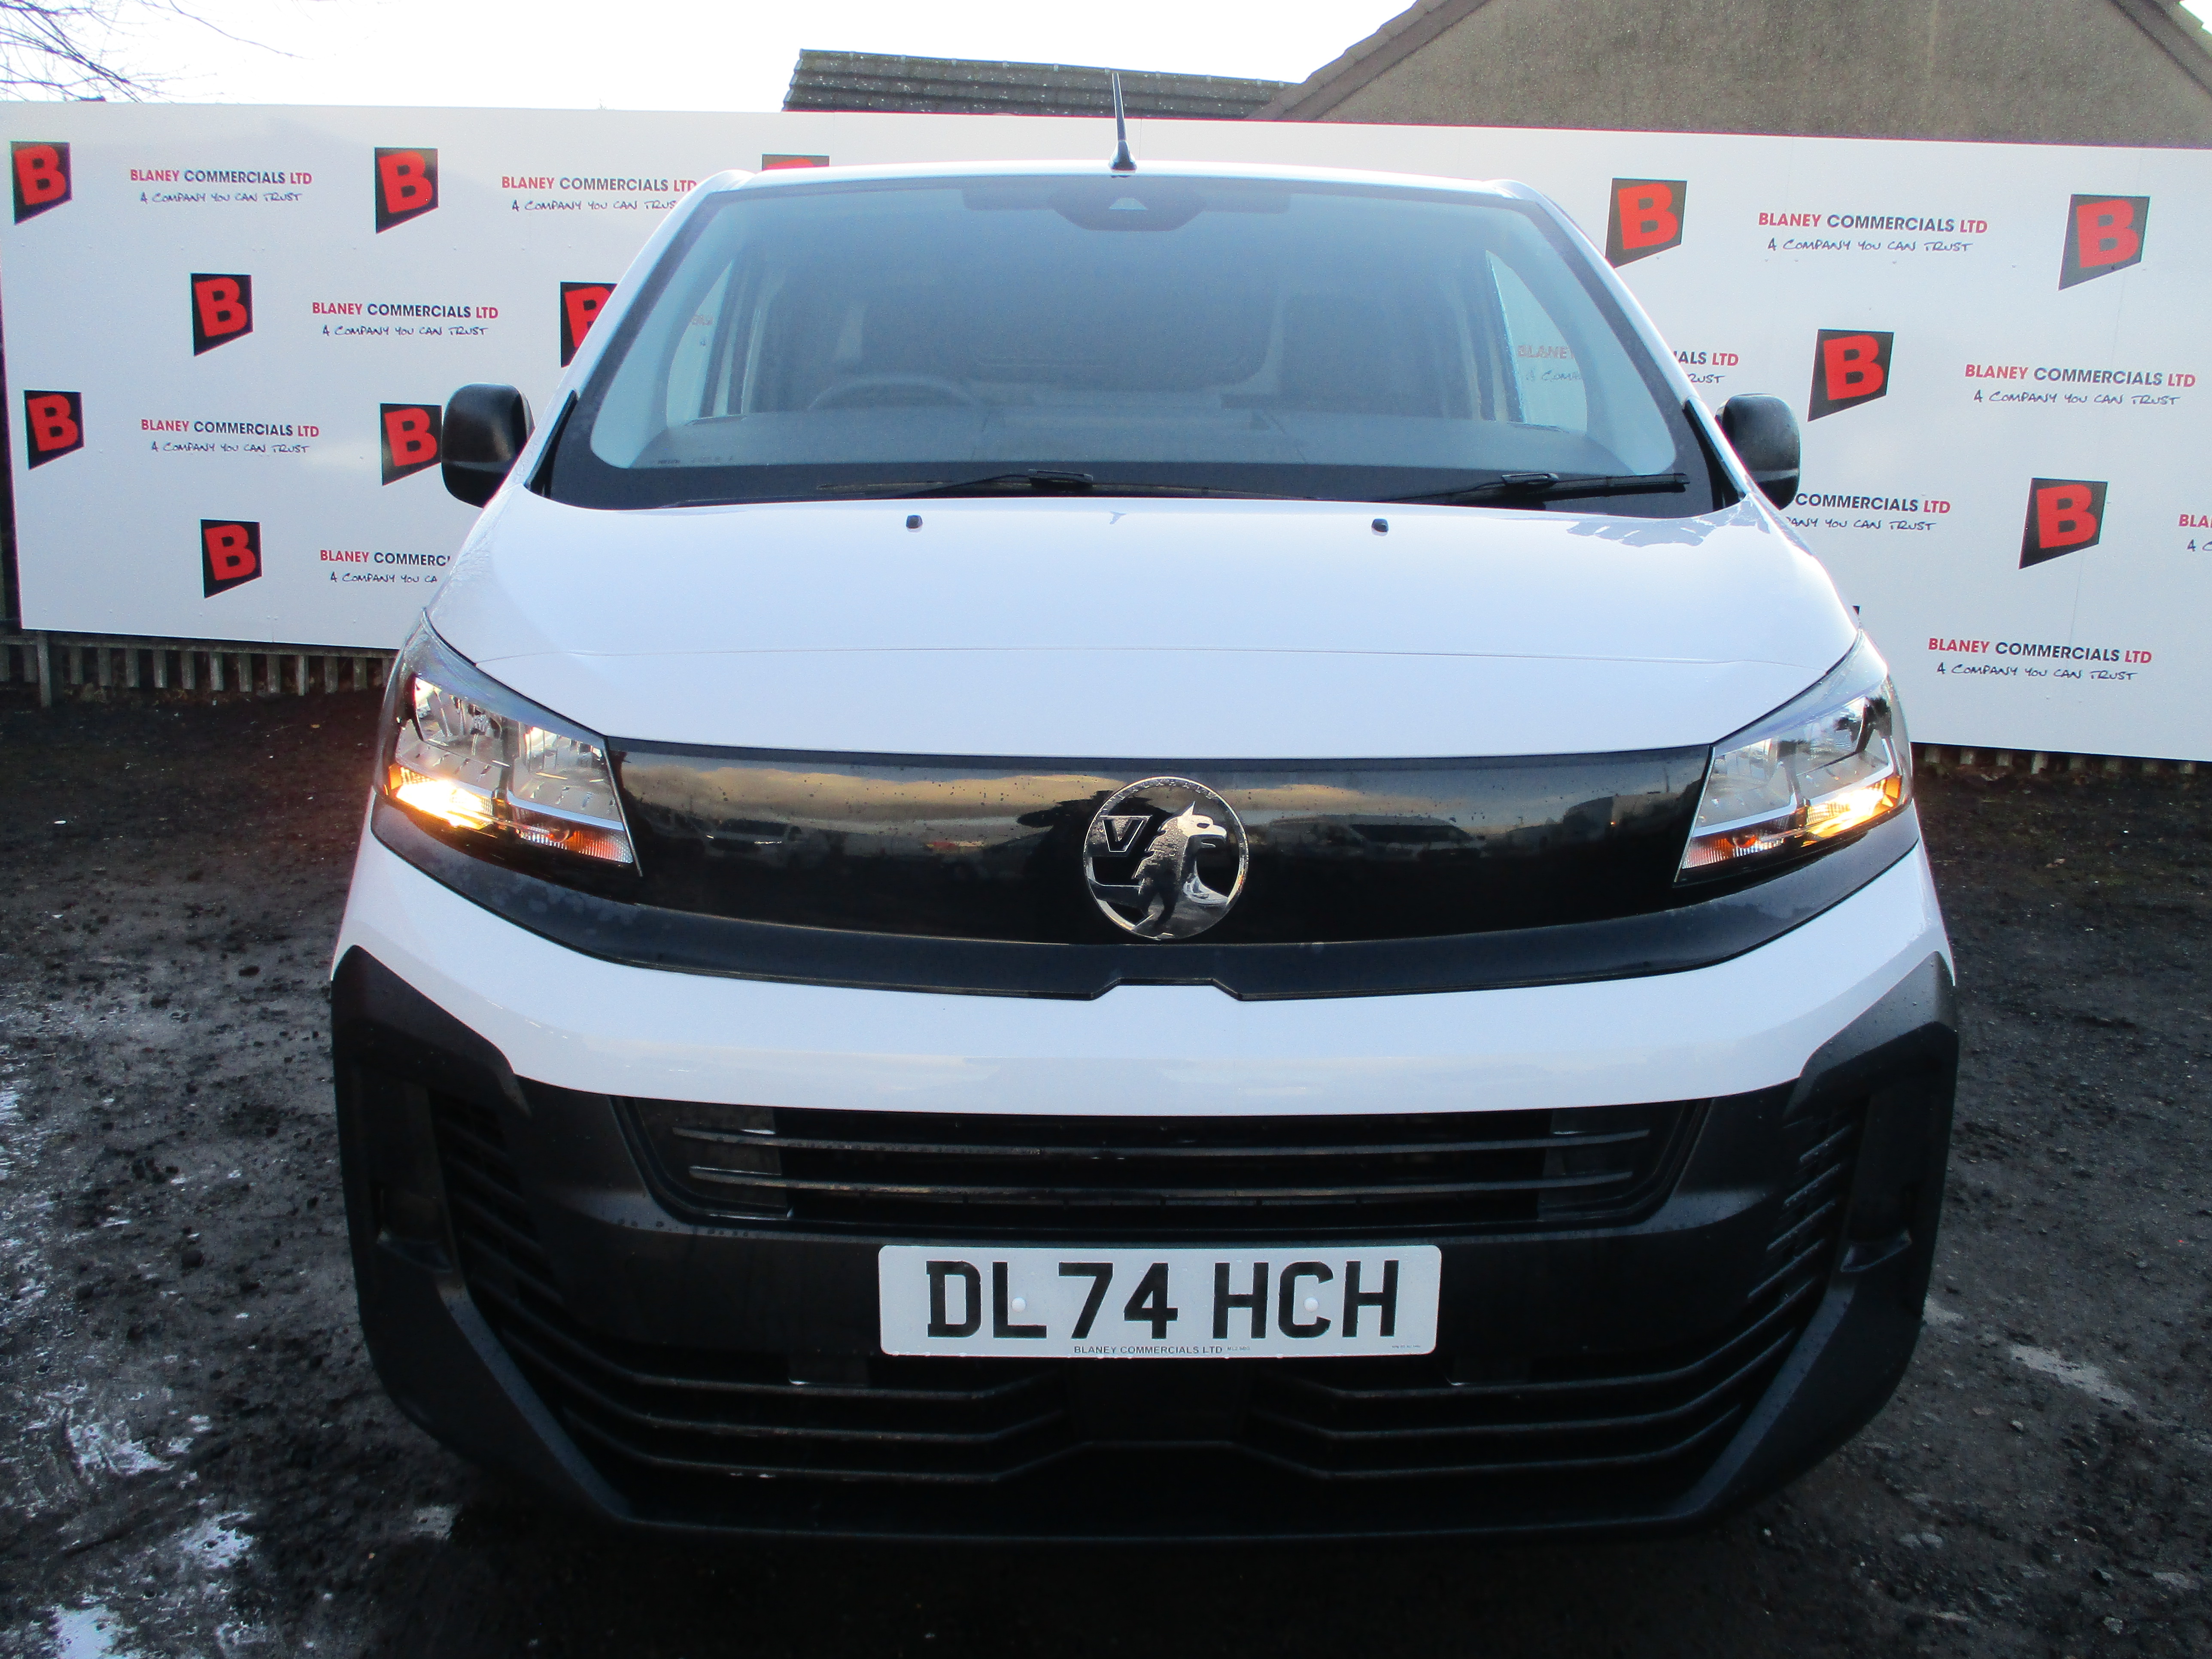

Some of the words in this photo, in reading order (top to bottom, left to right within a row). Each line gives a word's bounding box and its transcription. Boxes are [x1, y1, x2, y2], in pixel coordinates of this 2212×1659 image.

[14, 145, 66, 205] B
[130, 169, 180, 182] BLANEY
[184, 170, 286, 184] COMMERCIALS
[290, 172, 312, 185] LTD
[378, 151, 434, 213] B
[502, 176, 555, 189] BLANEY
[559, 177, 668, 192] COMMERCIALS
[674, 179, 696, 192] LTD
[140, 192, 148, 204] A
[152, 192, 206, 202] COMPANY
[211, 193, 230, 202] YOU
[235, 193, 258, 202] CAN
[263, 192, 302, 202] TRUST
[512, 199, 520, 212] A
[524, 200, 581, 210] COMPANY
[588, 201, 608, 210] YOU
[613, 201, 638, 210] CAN
[644, 200, 675, 210] TRUS
[1618, 183, 1678, 249] B
[1759, 212, 1822, 227] BLANEY
[1827, 214, 1954, 232] COMMERCIALS
[1960, 219, 1987, 233] LTD
[2078, 200, 2137, 267] B
[1768, 237, 1777, 251] A
[1782, 239, 1851, 250] COMPANY
[1858, 240, 1881, 250] YOU
[1887, 241, 1916, 252] CAN
[1923, 241, 1973, 252] TRUST
[194, 277, 248, 337] B
[312, 302, 362, 315] BLANEY
[367, 304, 471, 318] COMMERCIALS
[476, 307, 498, 319] LTD
[322, 325, 330, 337] A
[334, 325, 389, 336] COMPANY
[395, 327, 414, 335] YOU
[419, 327, 442, 336] CAN
[448, 326, 488, 335] TRUST
[1712, 352, 1739, 366] LTD
[1823, 334, 1884, 400] B
[1687, 373, 1725, 383] RUST
[1965, 364, 2029, 380] BLANEY
[2033, 368, 2163, 386] COMMERCIALS
[2168, 374, 2196, 387] LTD
[1973, 389, 1983, 403] A
[1989, 391, 2057, 403] COMPANY
[2064, 393, 2087, 403] YOU
[2094, 394, 2123, 404] CAN
[2131, 395, 2180, 405] TRUST
[28, 395, 78, 451] B
[141, 419, 189, 432] BLANEY
[194, 421, 293, 436] COMMERCIALS
[298, 425, 319, 437] LTD
[384, 407, 438, 467] B
[152, 441, 158, 452] A
[163, 442, 215, 452] COMPANY
[220, 444, 239, 452] YOU
[243, 444, 266, 453] CAN
[272, 444, 309, 453] TRUST
[1794, 492, 1918, 512] COMMERCIALS
[1923, 500, 1951, 514] LTD
[1825, 519, 1847, 528] YOU
[1853, 520, 1881, 529] CAN
[1889, 520, 1936, 531] TRUST
[2037, 484, 2097, 549] B
[2179, 514, 2212, 528] BLA
[205, 524, 256, 580] B
[2187, 539, 2196, 552] A
[320, 550, 369, 562] BLANEY
[374, 552, 450, 567] COMMERC
[330, 571, 337, 583] A
[342, 573, 395, 583] COMPANY
[401, 574, 419, 583] YOU
[1928, 638, 1990, 655] BLANEY
[1995, 642, 2120, 662] COMMERCIALS
[2124, 650, 2152, 663] LTD
[1937, 662, 1946, 675] A
[1951, 664, 2018, 676] COMPANY
[2024, 668, 2047, 677] YOU
[2053, 669, 2081, 679] CAN
[2090, 670, 2137, 681] TRUST
[926, 1261, 1178, 1339] DL74
[1212, 1260, 1399, 1339] HCH
